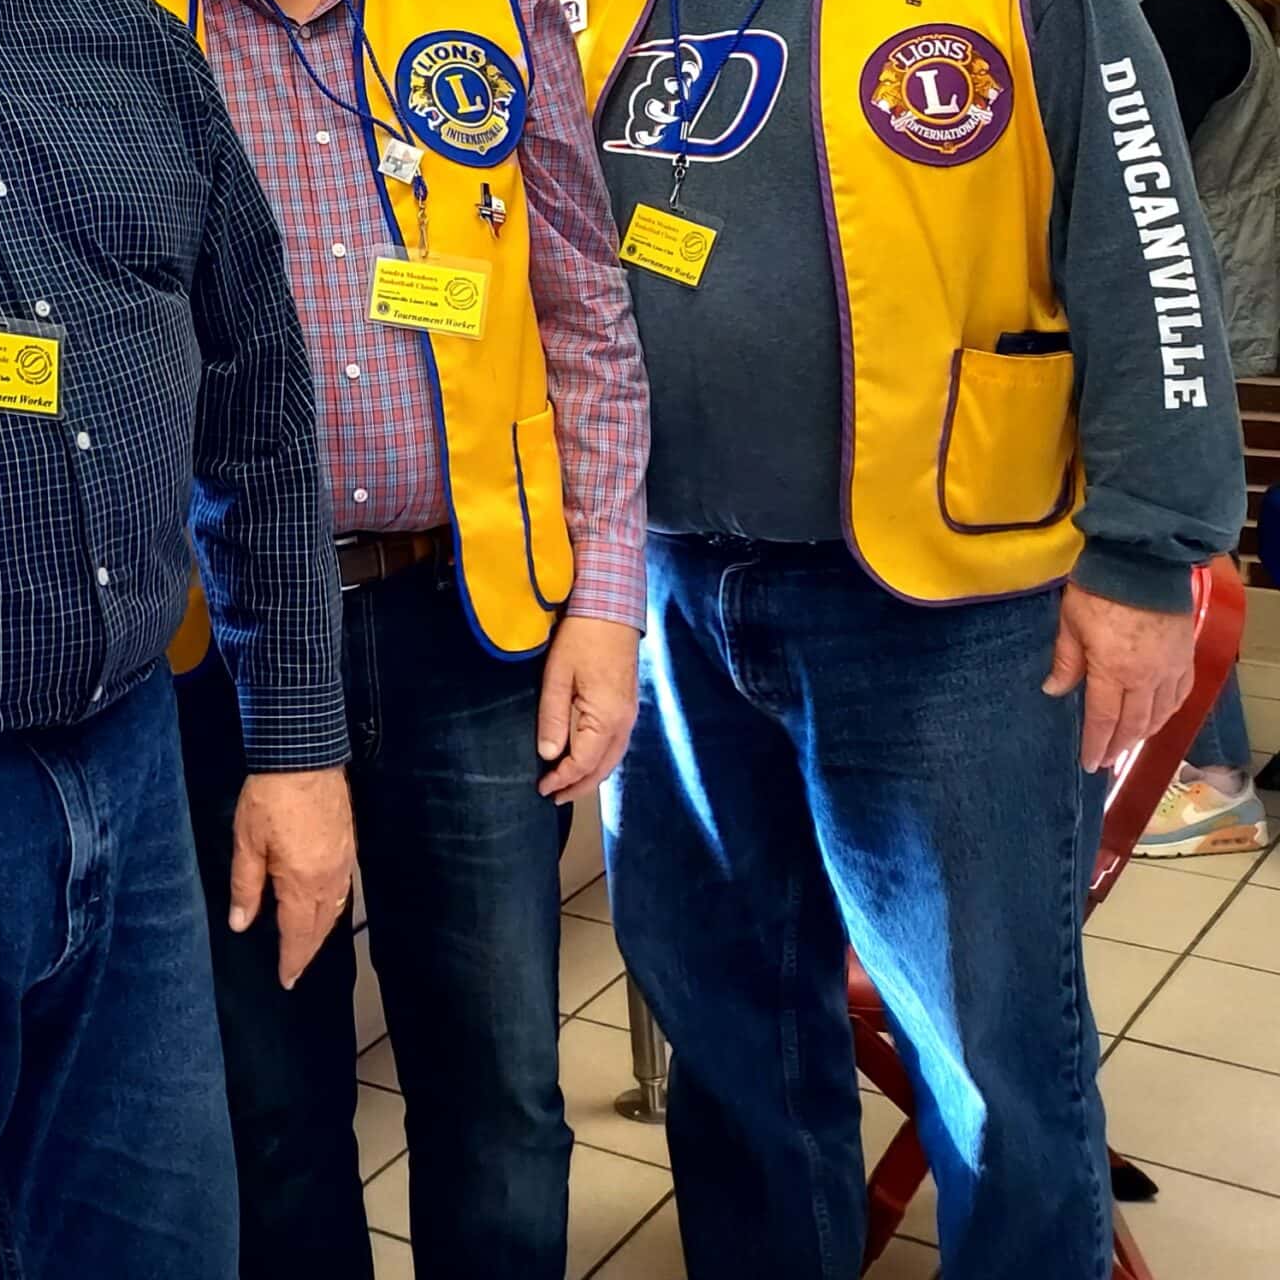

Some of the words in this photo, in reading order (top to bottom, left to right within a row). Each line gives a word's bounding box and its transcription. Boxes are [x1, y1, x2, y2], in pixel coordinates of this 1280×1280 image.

[417, 45, 482, 71] LIONS
[895, 39, 966, 66] LIONS
[445, 74, 485, 113] L
[916, 70, 960, 115] L
[447, 122, 503, 145] INTERNATIONAL
[905, 111, 983, 141] INTERNATIONAL
[1100, 56, 1208, 409] DUNCANVILLE
[393, 310, 443, 324] Tournament
[446, 318, 476, 329] Worker
[19, 395, 53, 407] Worker
